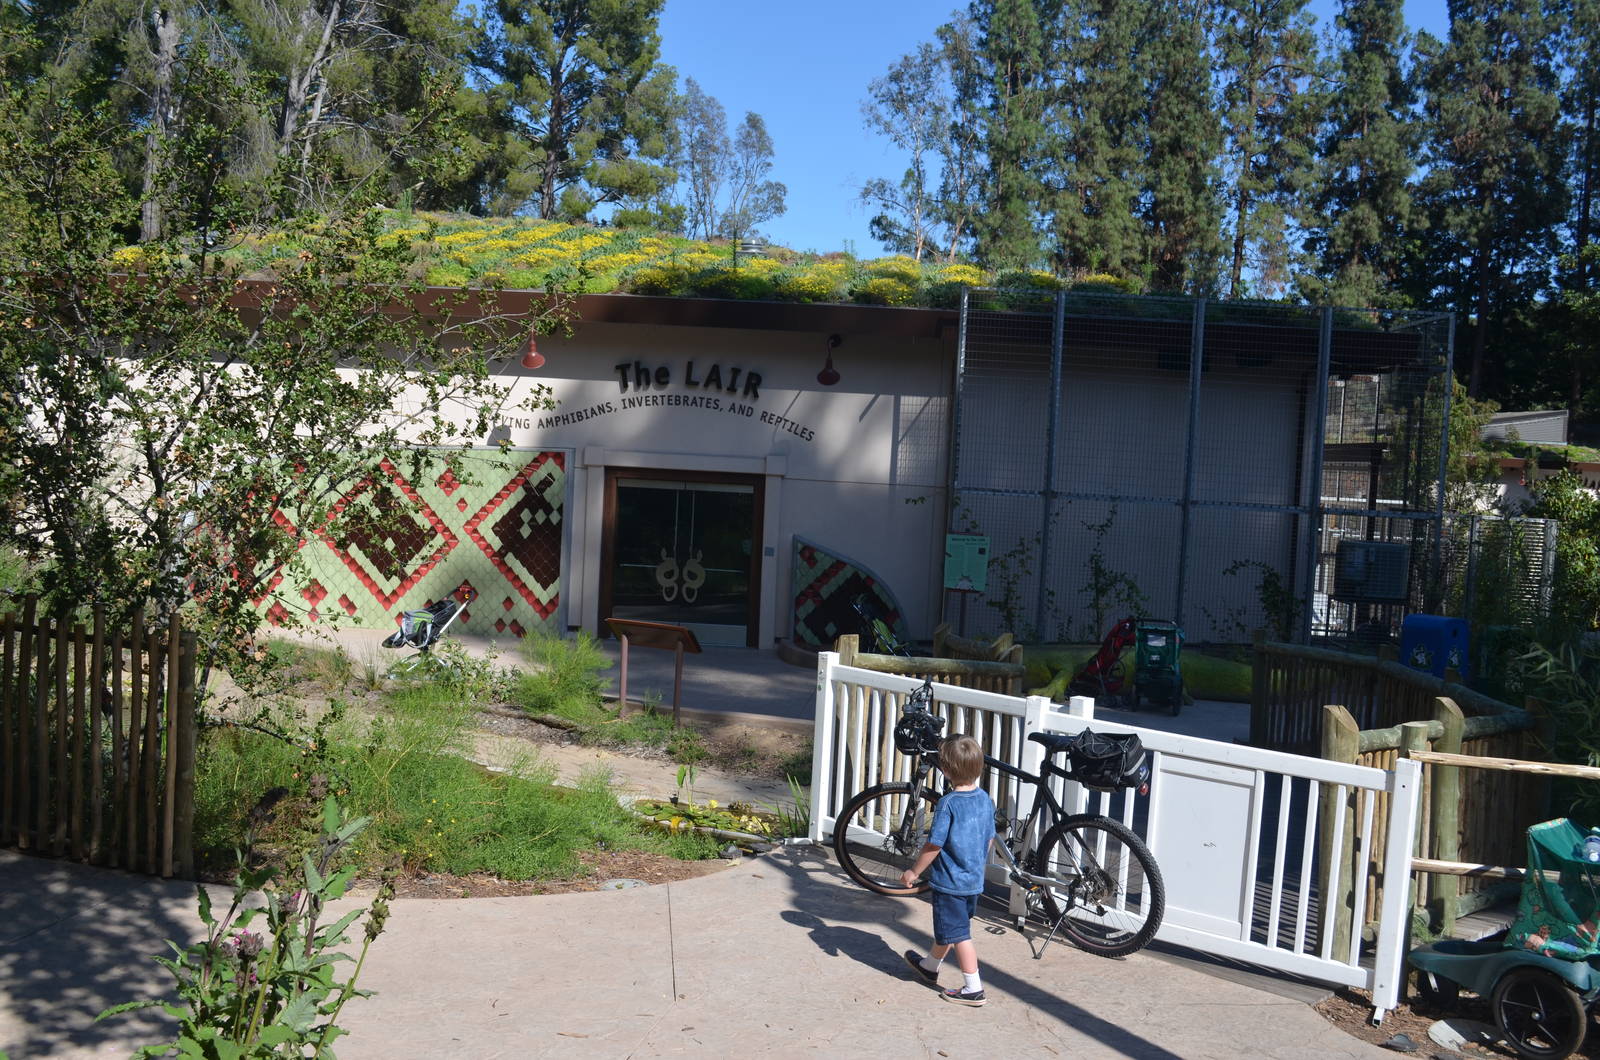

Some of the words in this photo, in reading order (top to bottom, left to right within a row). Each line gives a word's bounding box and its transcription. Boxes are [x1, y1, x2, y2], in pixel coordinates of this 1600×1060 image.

[615, 361, 670, 391] The
[685, 361, 763, 399] LAIR
[491, 411, 530, 430] VING
[537, 402, 618, 429] AMPHIBIANS,
[621, 395, 723, 412] INVERTEBRATES,
[728, 402, 754, 418] AND
[759, 410, 815, 442] REPTILES
